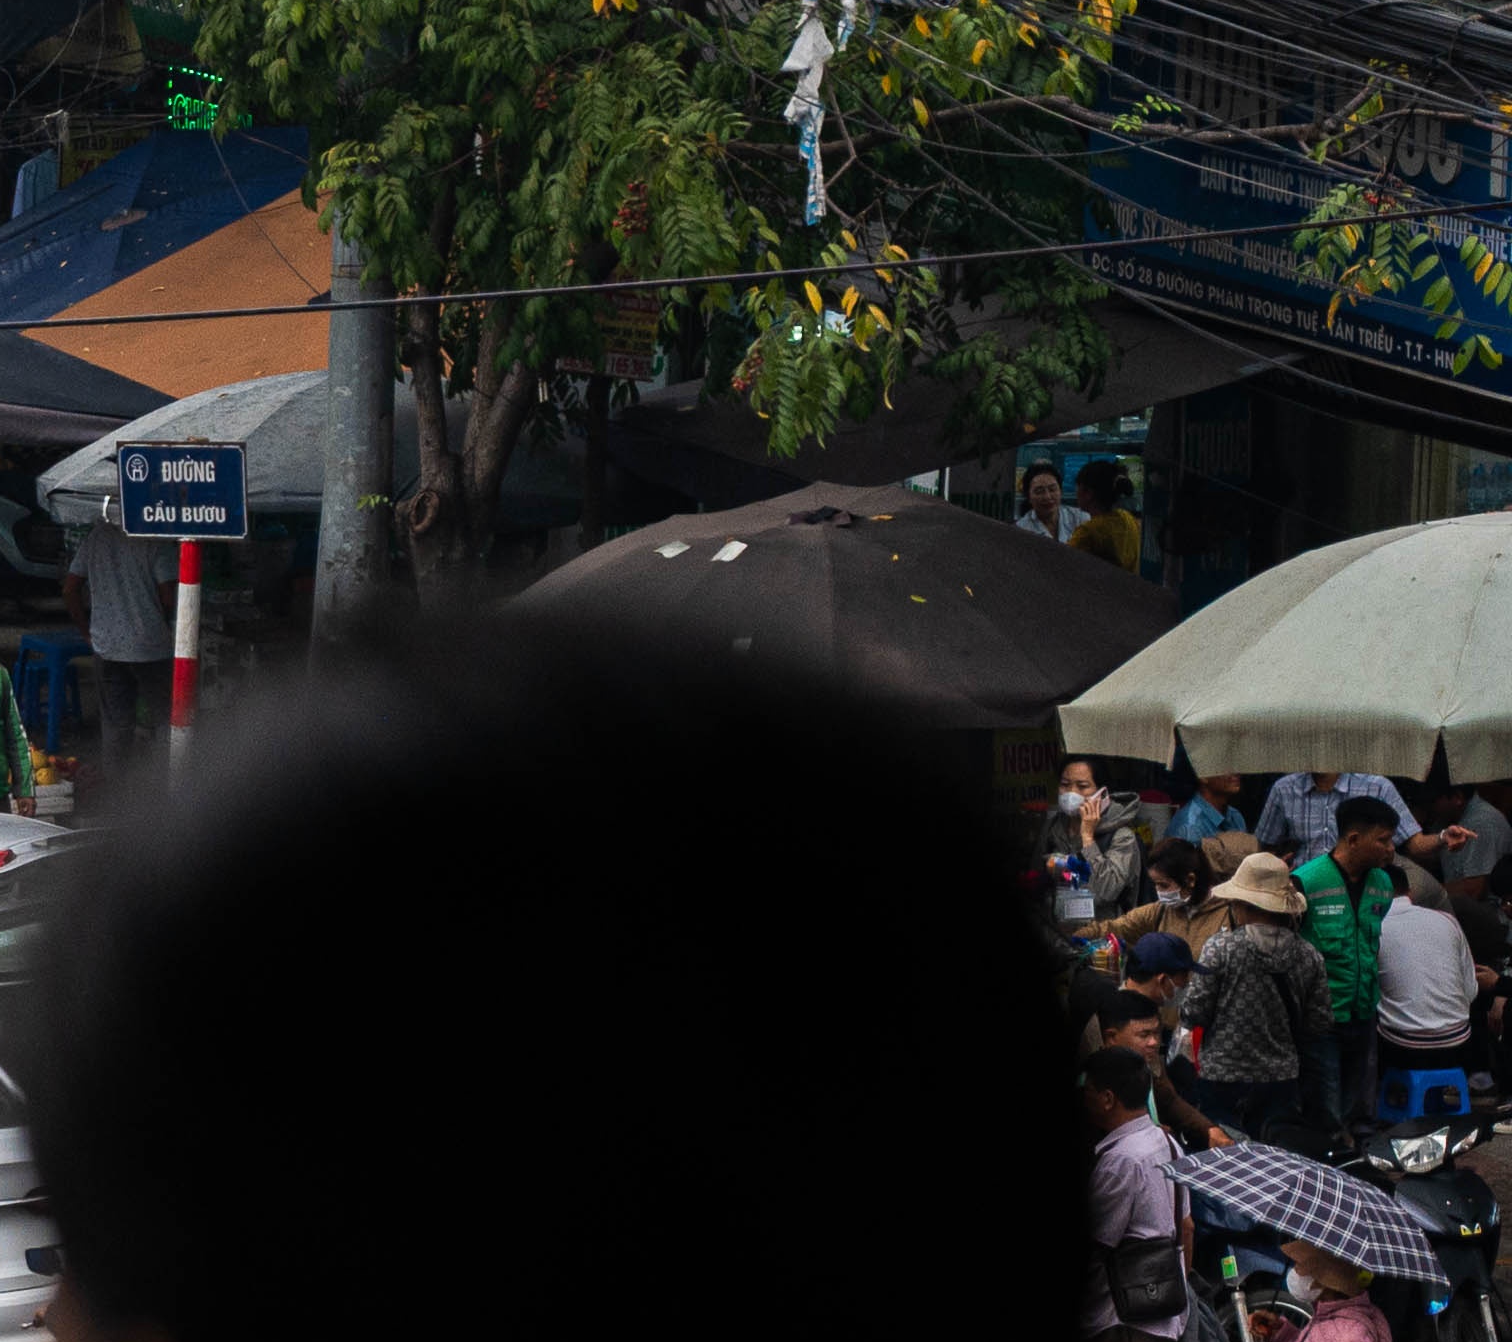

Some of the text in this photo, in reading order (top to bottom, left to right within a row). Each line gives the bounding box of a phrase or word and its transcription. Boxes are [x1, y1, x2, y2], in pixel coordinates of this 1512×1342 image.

[1091, 250, 1116, 274] ĐC:
[1117, 251, 1137, 279] SỐ
[1137, 264, 1154, 284] 28
[1156, 268, 1205, 300] ĐƯỜNG
[1207, 285, 1245, 312] PHAN
[1247, 293, 1293, 327] TRỌNG
[1296, 306, 1319, 337] TUỆ
[1328, 314, 1356, 344] TÂN
[1358, 322, 1394, 355] TRIỀU
[162, 455, 216, 483] ĐƯỜNG
[143, 500, 226, 523] CẦU BƯƠU
